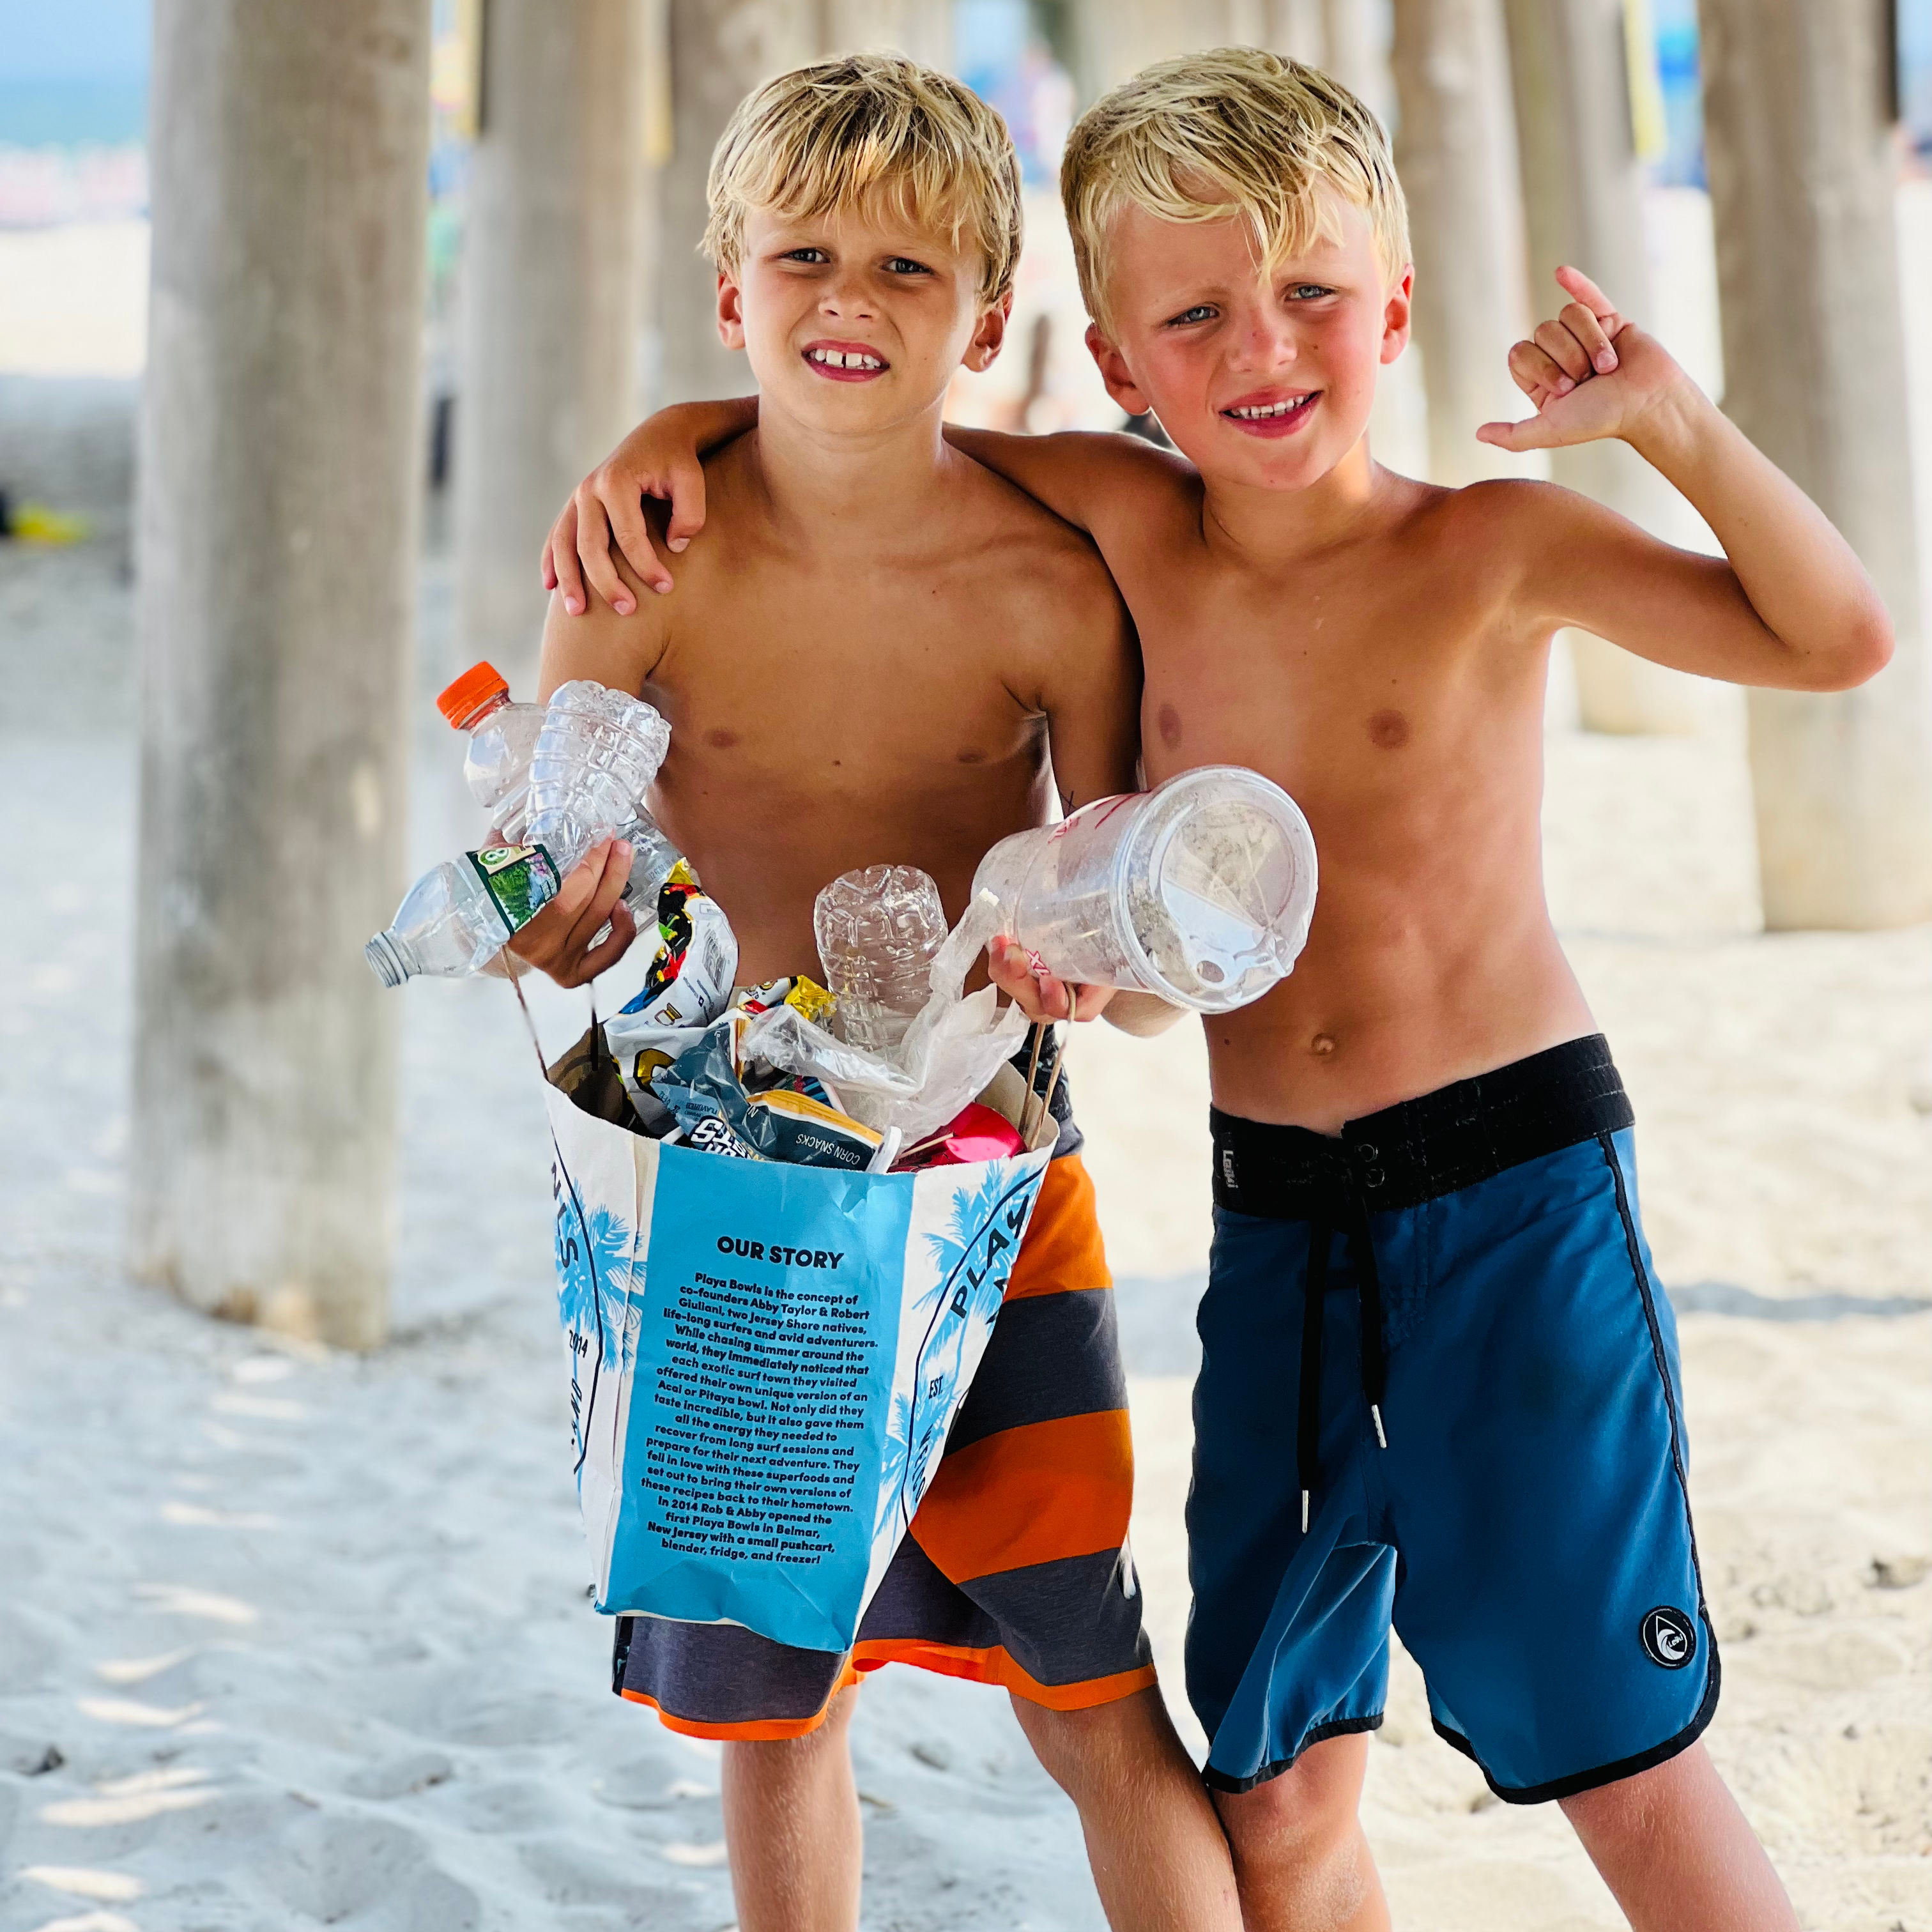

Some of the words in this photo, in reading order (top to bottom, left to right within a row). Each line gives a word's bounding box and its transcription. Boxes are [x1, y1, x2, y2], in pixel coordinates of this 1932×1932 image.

[795, 1133, 835, 1154] SNACKS
[833, 1146, 861, 1165] CORN
[717, 1236, 765, 1261] OUR
[769, 1245, 845, 1269] STORY
[679, 1286, 749, 1306] co-founders
[749, 1298, 779, 1315] Abby
[781, 1303, 818, 1317] Taylor
[818, 1307, 828, 1317] &
[831, 1307, 870, 1320] Robert
[694, 1272, 727, 1289] Playa
[729, 1278, 762, 1294] Bowls
[763, 1285, 774, 1298] is
[775, 1289, 795, 1300] the
[797, 1293, 844, 1306] concept
[845, 1294, 859, 1305] of
[663, 1307, 711, 1329] life-long
[713, 1320, 753, 1335] surfers
[754, 1330, 777, 1340] and
[778, 1332, 805, 1344] avid
[806, 1335, 878, 1347] adventurers.
[678, 1298, 725, 1317] Giuliani,
[727, 1308, 748, 1320] two
[748, 1312, 785, 1330] Jersey
[786, 1318, 820, 1331] Shore
[822, 1322, 867, 1335] natives,
[569, 1329, 588, 1358] 2014
[666, 1338, 700, 1354] world,
[702, 1345, 727, 1361] they
[728, 1349, 799, 1374] immediately
[800, 1363, 844, 1374] noticed
[845, 1364, 870, 1375] that
[675, 1323, 706, 1340] While
[707, 1331, 752, 1352] chasing
[753, 1344, 801, 1357] summer
[802, 1351, 844, 1361] around
[845, 1351, 864, 1361] the
[656, 1366, 698, 1383] offered
[700, 1375, 728, 1388] their
[728, 1383, 753, 1393] own
[755, 1386, 795, 1400] unique
[796, 1390, 837, 1400] version
[839, 1392, 853, 1401] of
[671, 1356, 699, 1368] each
[701, 1363, 735, 1376] exotic
[737, 1370, 762, 1381] surf
[762, 1372, 790, 1385] town
[793, 1376, 818, 1389] they
[819, 1377, 857, 1388] visited
[654, 1393, 682, 1409] taste
[683, 1400, 744, 1422] incredible,
[746, 1411, 767, 1423] but
[767, 1414, 777, 1425] it
[778, 1416, 802, 1427] also
[804, 1420, 833, 1430] gave
[835, 1419, 864, 1429] them
[684, 1388, 697, 1397] or
[698, 1388, 735, 1406] Pitaya
[737, 1396, 768, 1410] bowl.
[770, 1401, 791, 1413] Not
[793, 1404, 817, 1416] only
[818, 1404, 837, 1414] did
[839, 1405, 864, 1418] they
[655, 1425, 698, 1440] recover
[699, 1432, 726, 1446] from
[729, 1437, 755, 1452] long
[756, 1443, 781, 1453] surf
[783, 1445, 829, 1455] sessions
[832, 1446, 854, 1456] and
[675, 1414, 690, 1425] all
[691, 1416, 710, 1429] the
[712, 1423, 753, 1438] energy
[754, 1427, 780, 1441] they
[781, 1430, 824, 1441] needed
[825, 1432, 838, 1441] to
[646, 1437, 691, 1453] prepare
[693, 1445, 710, 1457] for
[711, 1449, 740, 1462] their
[741, 1455, 767, 1464] next
[769, 1457, 830, 1469] adventure.
[832, 1459, 860, 1473] They
[647, 1450, 665, 1462] fell
[666, 1454, 678, 1466] in
[680, 1457, 703, 1471] love
[705, 1463, 730, 1475] with
[732, 1466, 764, 1478] these
[766, 1472, 831, 1483] superfoods
[832, 1475, 855, 1484] and
[641, 1477, 671, 1492] these
[673, 1487, 715, 1501] recipes
[717, 1491, 746, 1504] back
[747, 1495, 759, 1505] to
[761, 1496, 790, 1508] their
[791, 1498, 854, 1512] hometown.
[647, 1466, 664, 1476] set
[666, 1471, 685, 1482] out
[686, 1473, 698, 1483] to
[700, 1475, 732, 1491] bring
[734, 1480, 762, 1491] their
[763, 1485, 787, 1494] own
[790, 1487, 837, 1498] versions
[839, 1488, 852, 1498] of
[657, 1495, 669, 1507] In
[671, 1499, 698, 1512] 2014
[701, 1503, 723, 1515] Rob
[725, 1506, 735, 1516] &
[736, 1507, 767, 1521] Abby
[768, 1512, 811, 1523] opened
[813, 1514, 832, 1524] the
[665, 1512, 691, 1524] first
[692, 1515, 724, 1530] Playa
[726, 1519, 760, 1532] Bowls
[762, 1522, 774, 1533] in
[776, 1524, 820, 1539] Belmar,
[647, 1521, 672, 1535] New
[671, 1526, 709, 1543] Jersey
[710, 1532, 735, 1544] with
[737, 1537, 746, 1545] a
[747, 1537, 779, 1548] small
[780, 1540, 835, 1553] pushcart,
[661, 1538, 707, 1556] blender,
[710, 1545, 748, 1560] fridge,
[751, 1551, 774, 1561] and
[776, 1552, 821, 1564] freezer!
